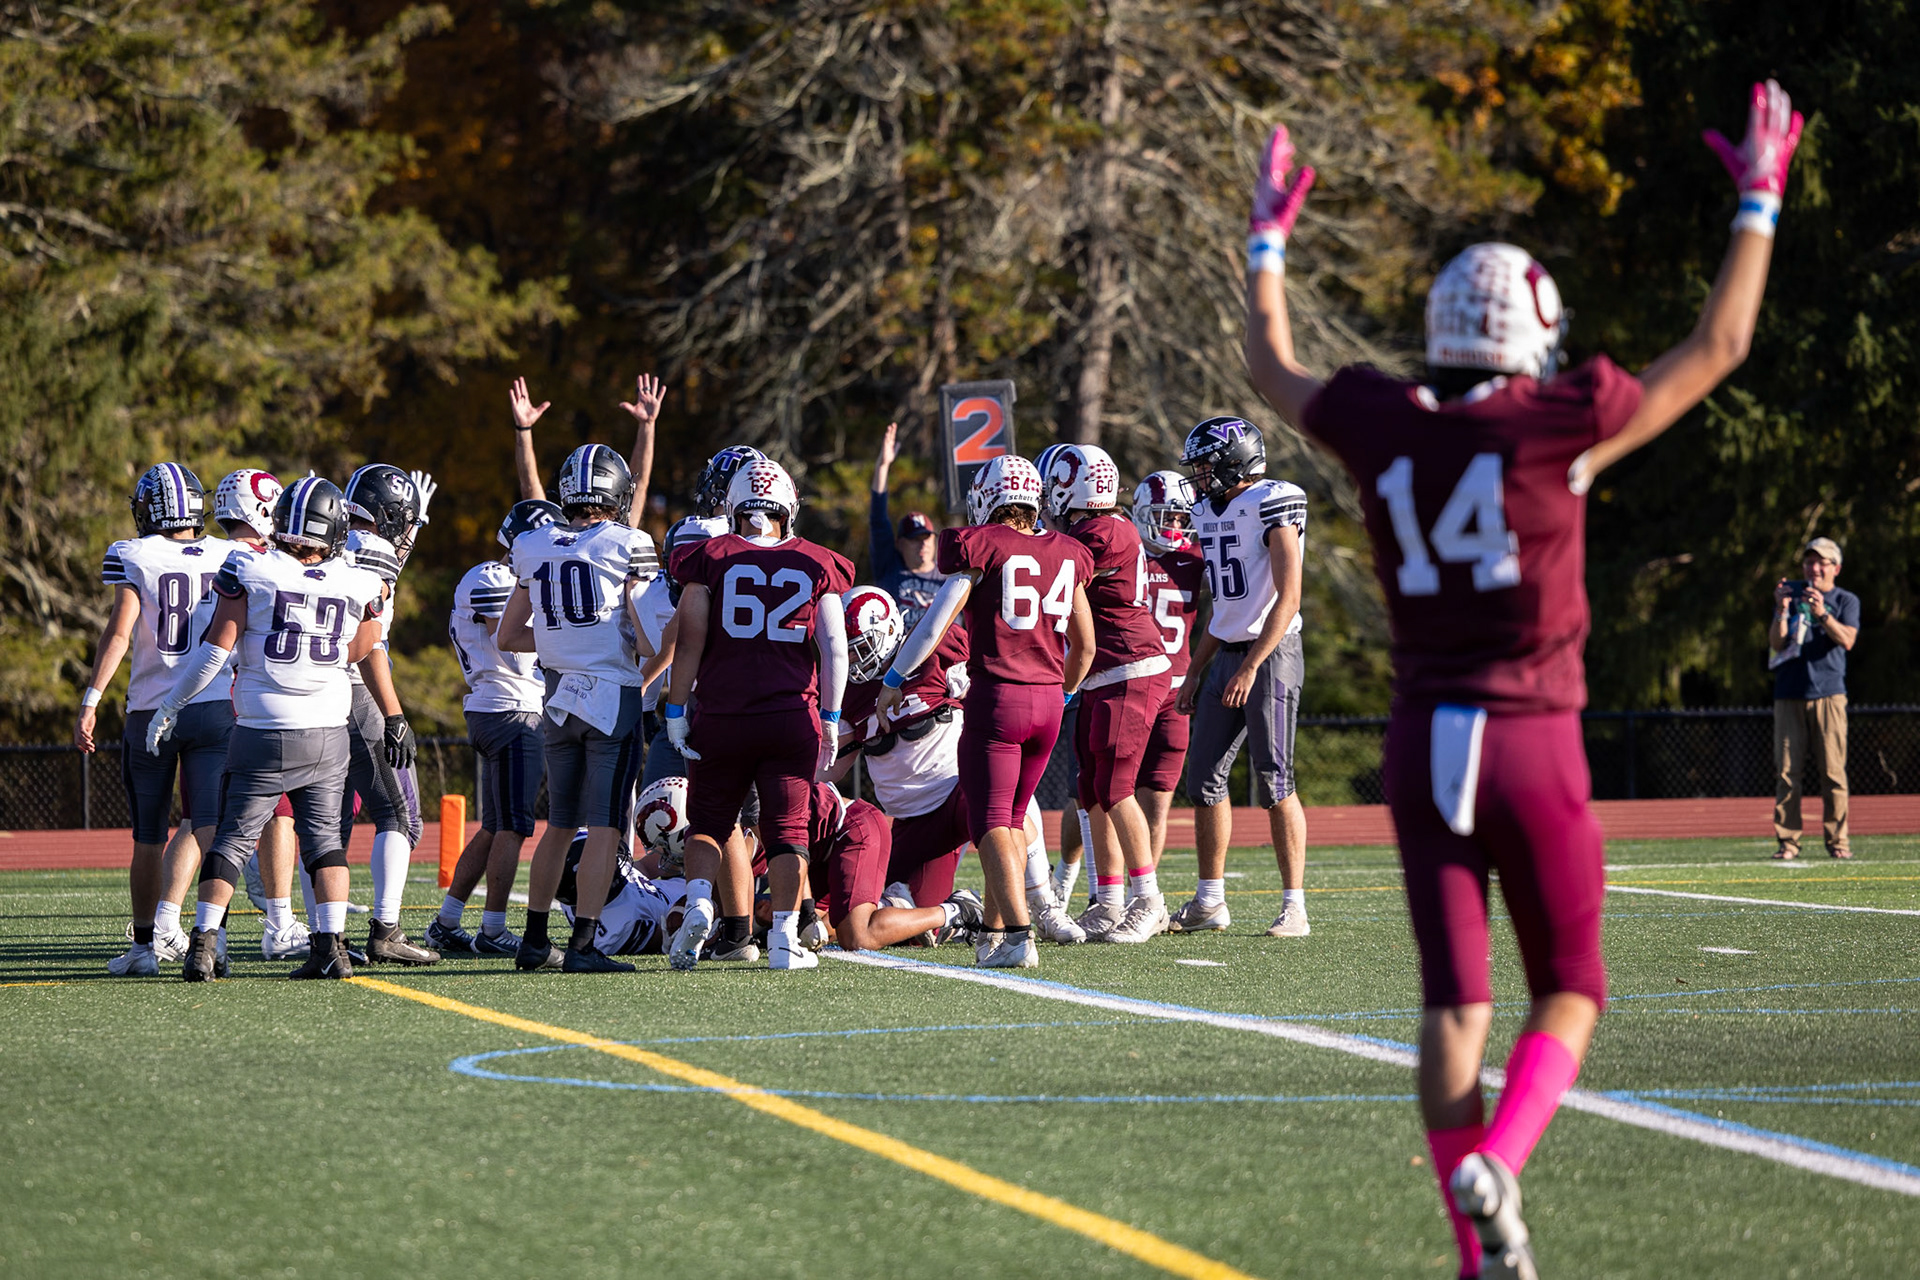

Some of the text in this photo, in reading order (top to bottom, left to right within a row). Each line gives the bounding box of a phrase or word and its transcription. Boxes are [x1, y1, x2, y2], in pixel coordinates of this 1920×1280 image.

[952, 397, 1006, 465] 2
[1206, 419, 1246, 444] VT
[217, 493, 226, 508] 51
[391, 474, 414, 502] 50
[566, 495, 603, 505] Riddell
[751, 479, 772, 495] 62
[1011, 476, 1030, 491] 64
[161, 518, 199, 528] Riddell
[1376, 452, 1521, 597] 14
[1148, 573, 1169, 583] AMS
[1200, 534, 1249, 602] 55
[532, 560, 601, 631] 10
[721, 564, 814, 643] 62
[1001, 554, 1076, 634] 64
[263, 589, 347, 666] 53
[1148, 588, 1193, 655] 5
